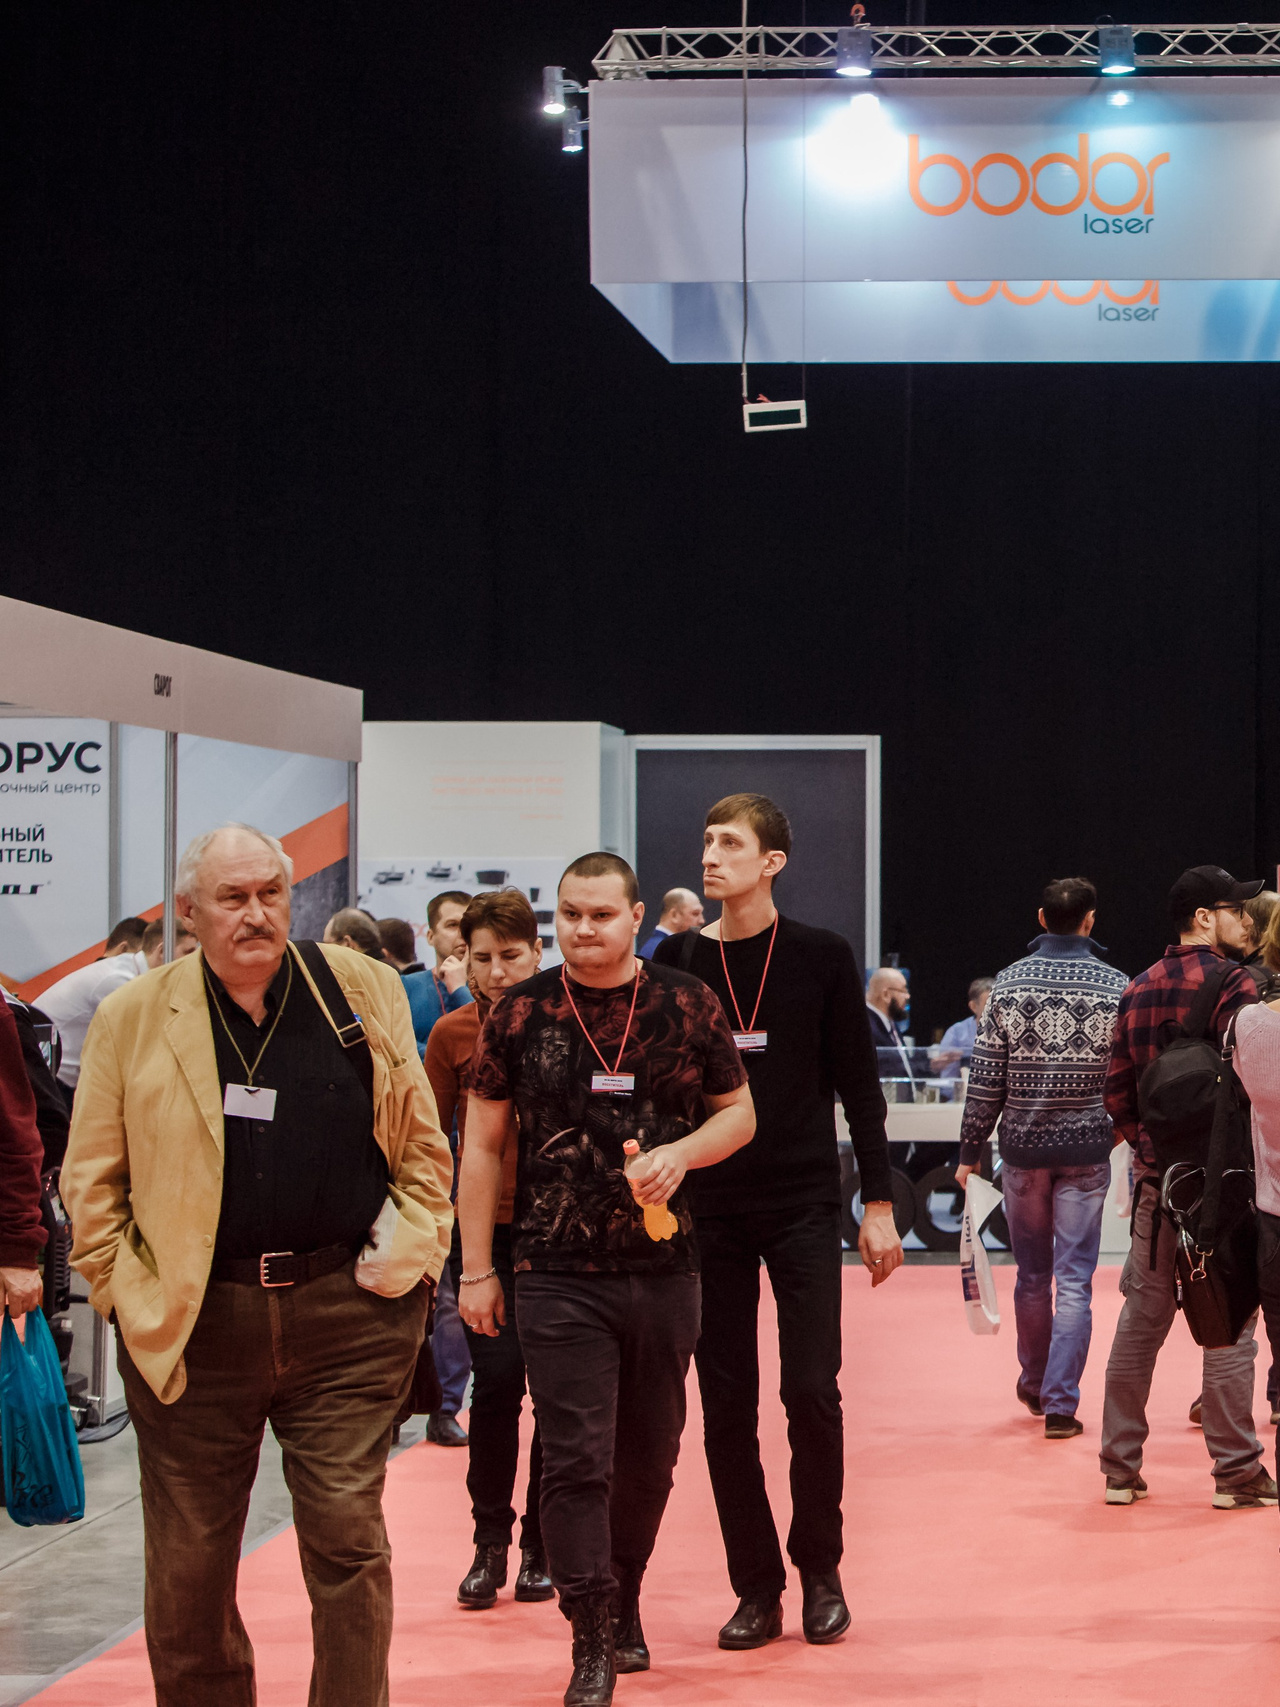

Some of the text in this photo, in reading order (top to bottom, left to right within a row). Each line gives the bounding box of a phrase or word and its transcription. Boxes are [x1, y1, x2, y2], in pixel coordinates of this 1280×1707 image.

[908, 133, 1170, 216] bodor
[1083, 213, 1155, 234] laser
[1098, 303, 1160, 321] laser
[54, 782, 101, 796] центр
[0, 823, 46, 842] НЫЙ
